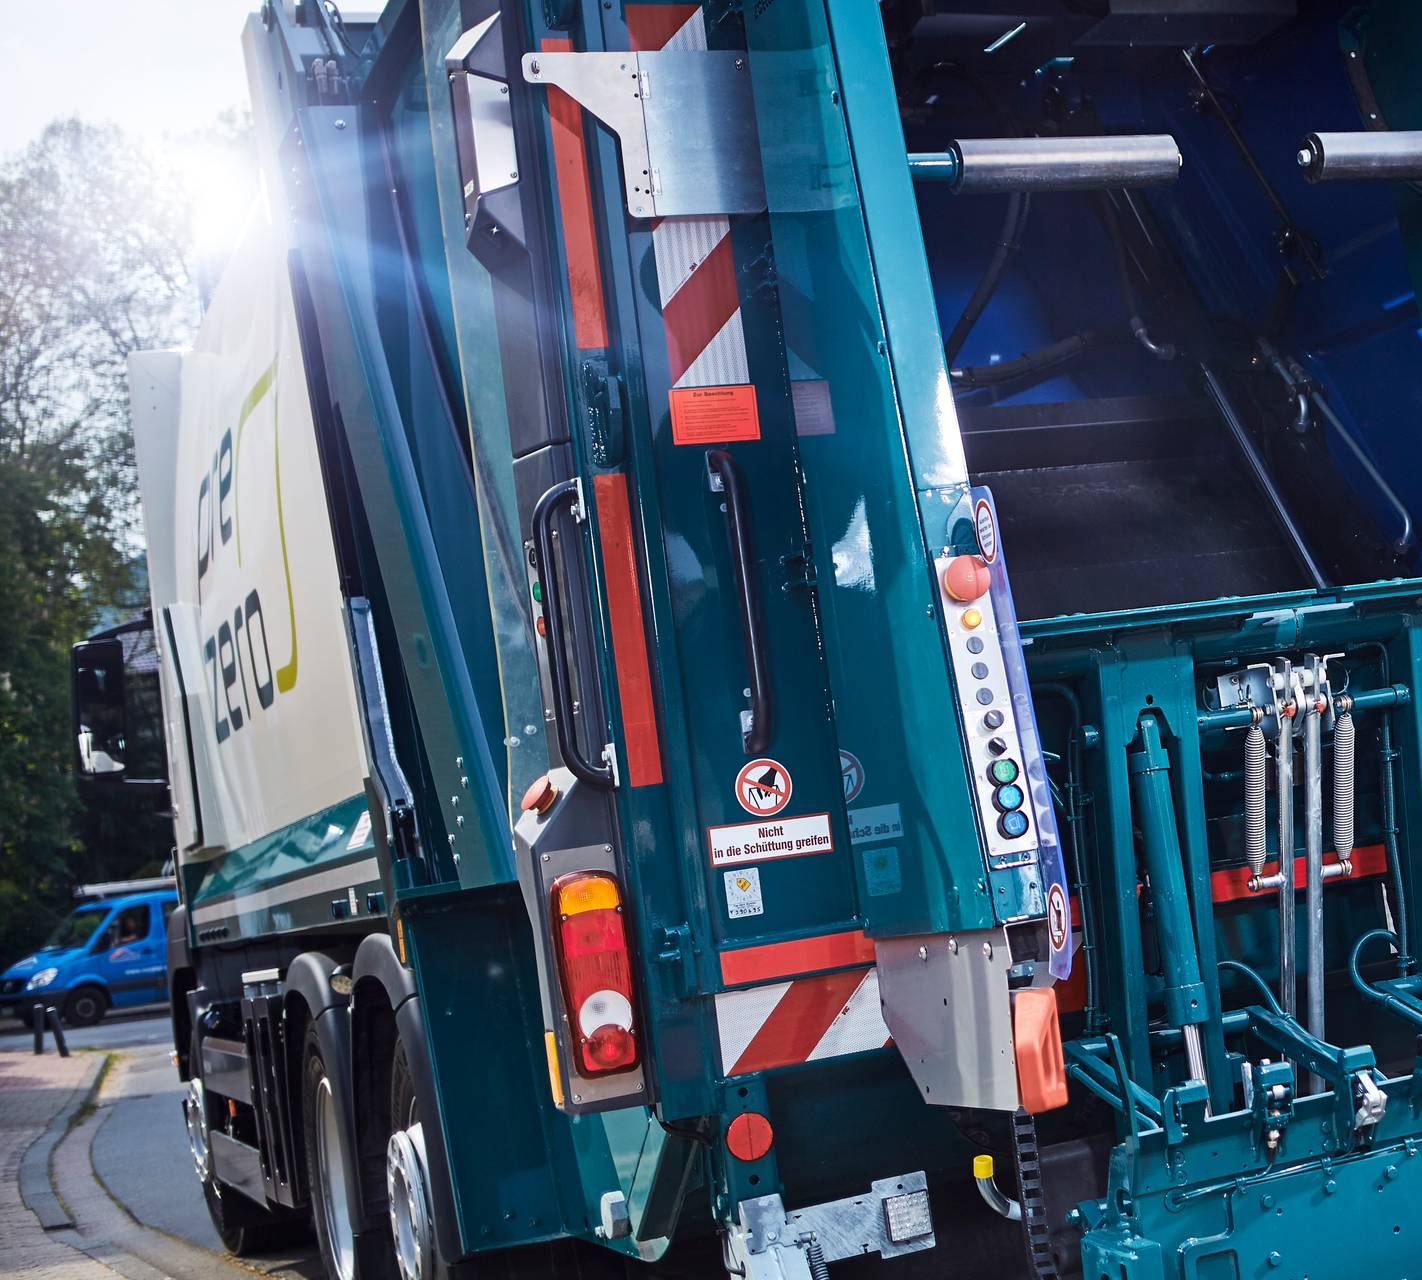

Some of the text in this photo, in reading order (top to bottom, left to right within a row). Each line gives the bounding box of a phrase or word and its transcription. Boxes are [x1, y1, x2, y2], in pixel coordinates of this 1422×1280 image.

[197, 427, 232, 614] pre
[204, 588, 274, 744] zero
[714, 834, 829, 859] in die Schüttung greifen
[758, 825, 784, 839] Nicht
